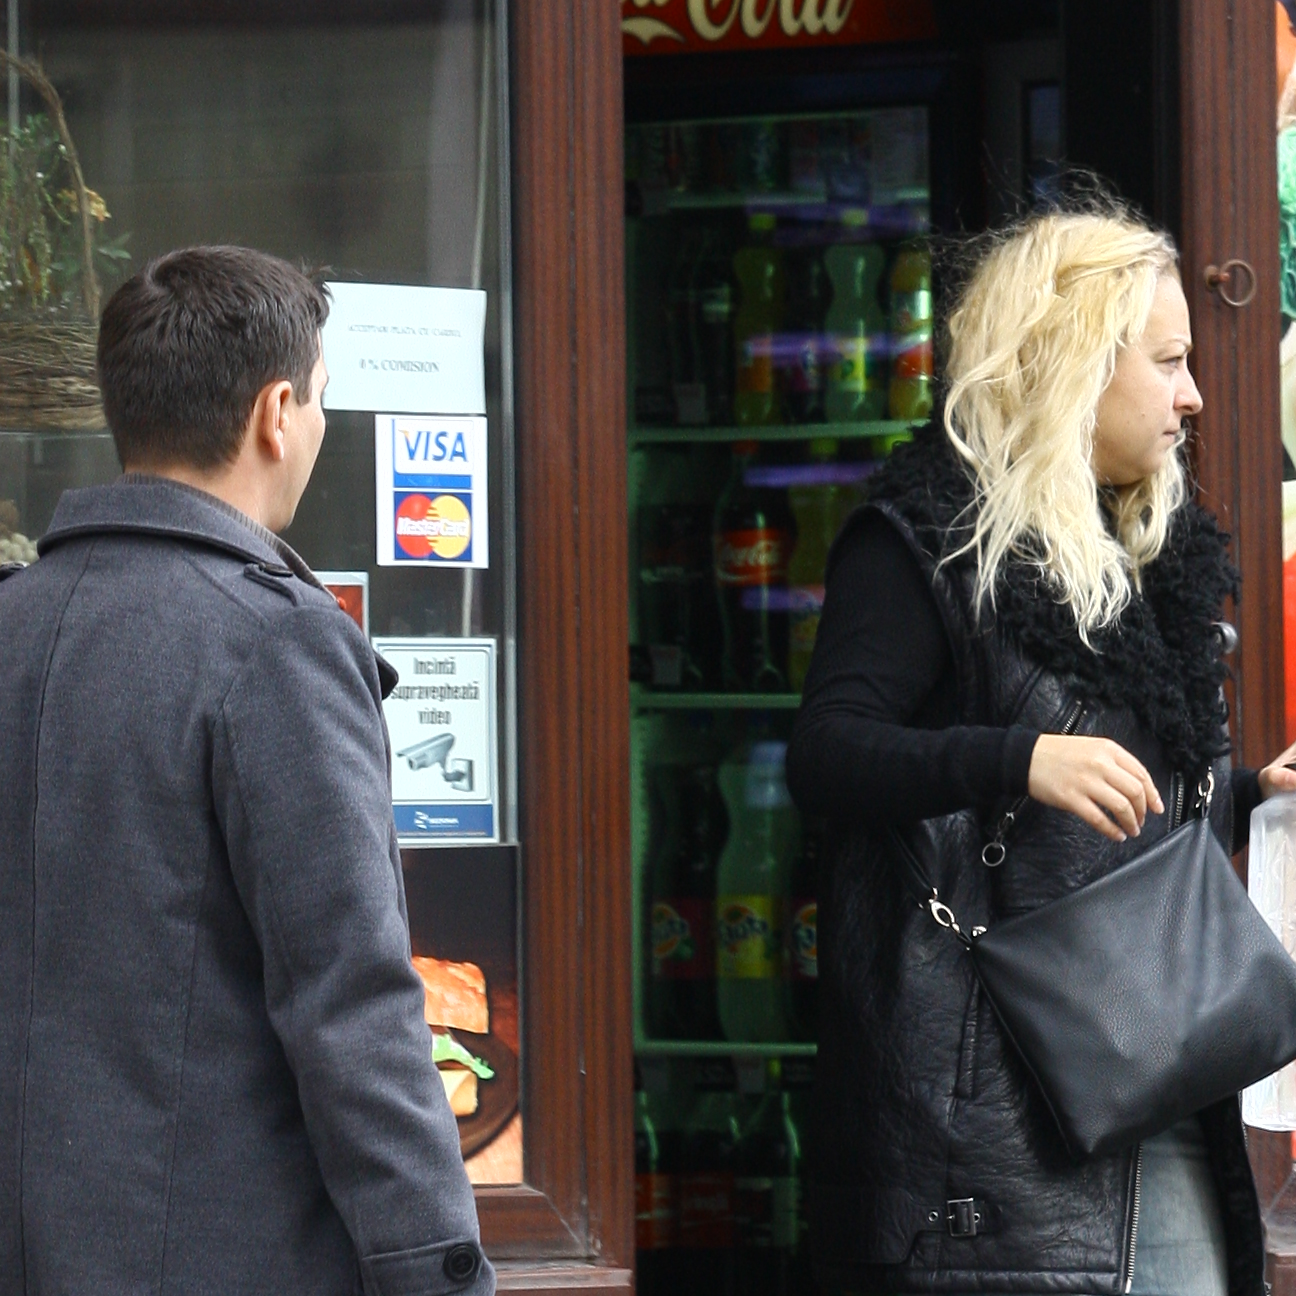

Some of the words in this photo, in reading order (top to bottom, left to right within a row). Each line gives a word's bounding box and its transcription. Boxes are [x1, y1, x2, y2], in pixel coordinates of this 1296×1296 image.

[398, 429, 469, 462] VISA
[396, 516, 470, 538] MasterCard
[413, 656, 457, 675] Incintă
[417, 706, 453, 726] video
